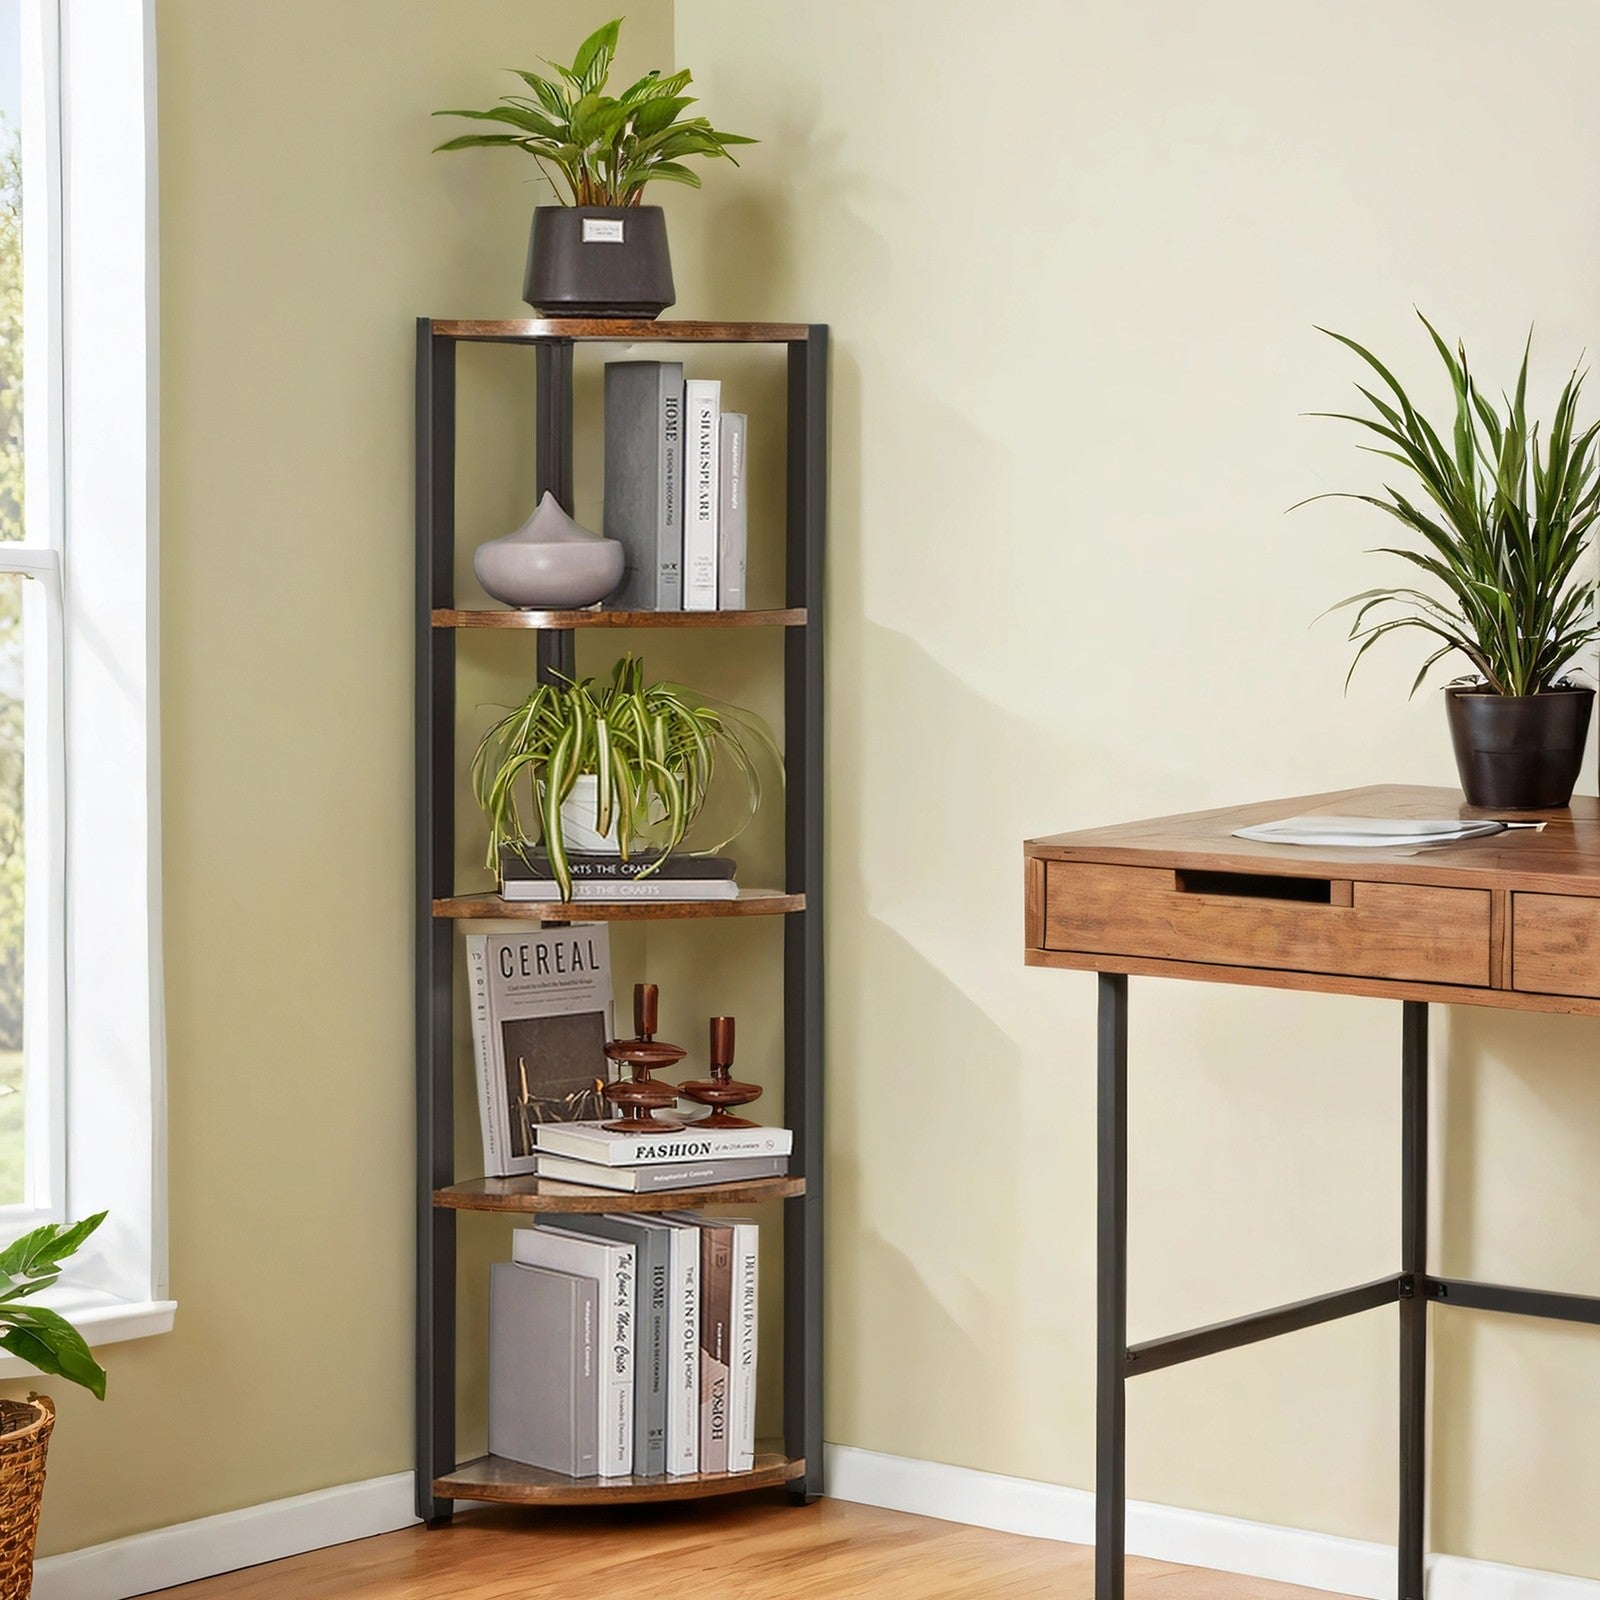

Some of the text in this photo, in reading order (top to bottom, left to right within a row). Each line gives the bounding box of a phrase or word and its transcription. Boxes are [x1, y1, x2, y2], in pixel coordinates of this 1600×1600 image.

[665, 397, 678, 441] HOME
[699, 409, 711, 520] SHAKESPEARE
[596, 864, 617, 875] THE
[596, 885, 617, 896] THE
[620, 885, 660, 896] CRAFTS
[500, 940, 600, 978] CEREAL
[636, 1142, 711, 1159] FASHION
[617, 1253, 632, 1271] The
[653, 1266, 665, 1309] HOME
[616, 1311, 630, 1343] Monte
[683, 1289, 694, 1361] KINFOLK
[685, 1363, 693, 1389] HOME
[712, 1377, 725, 1441] HOPSCA
